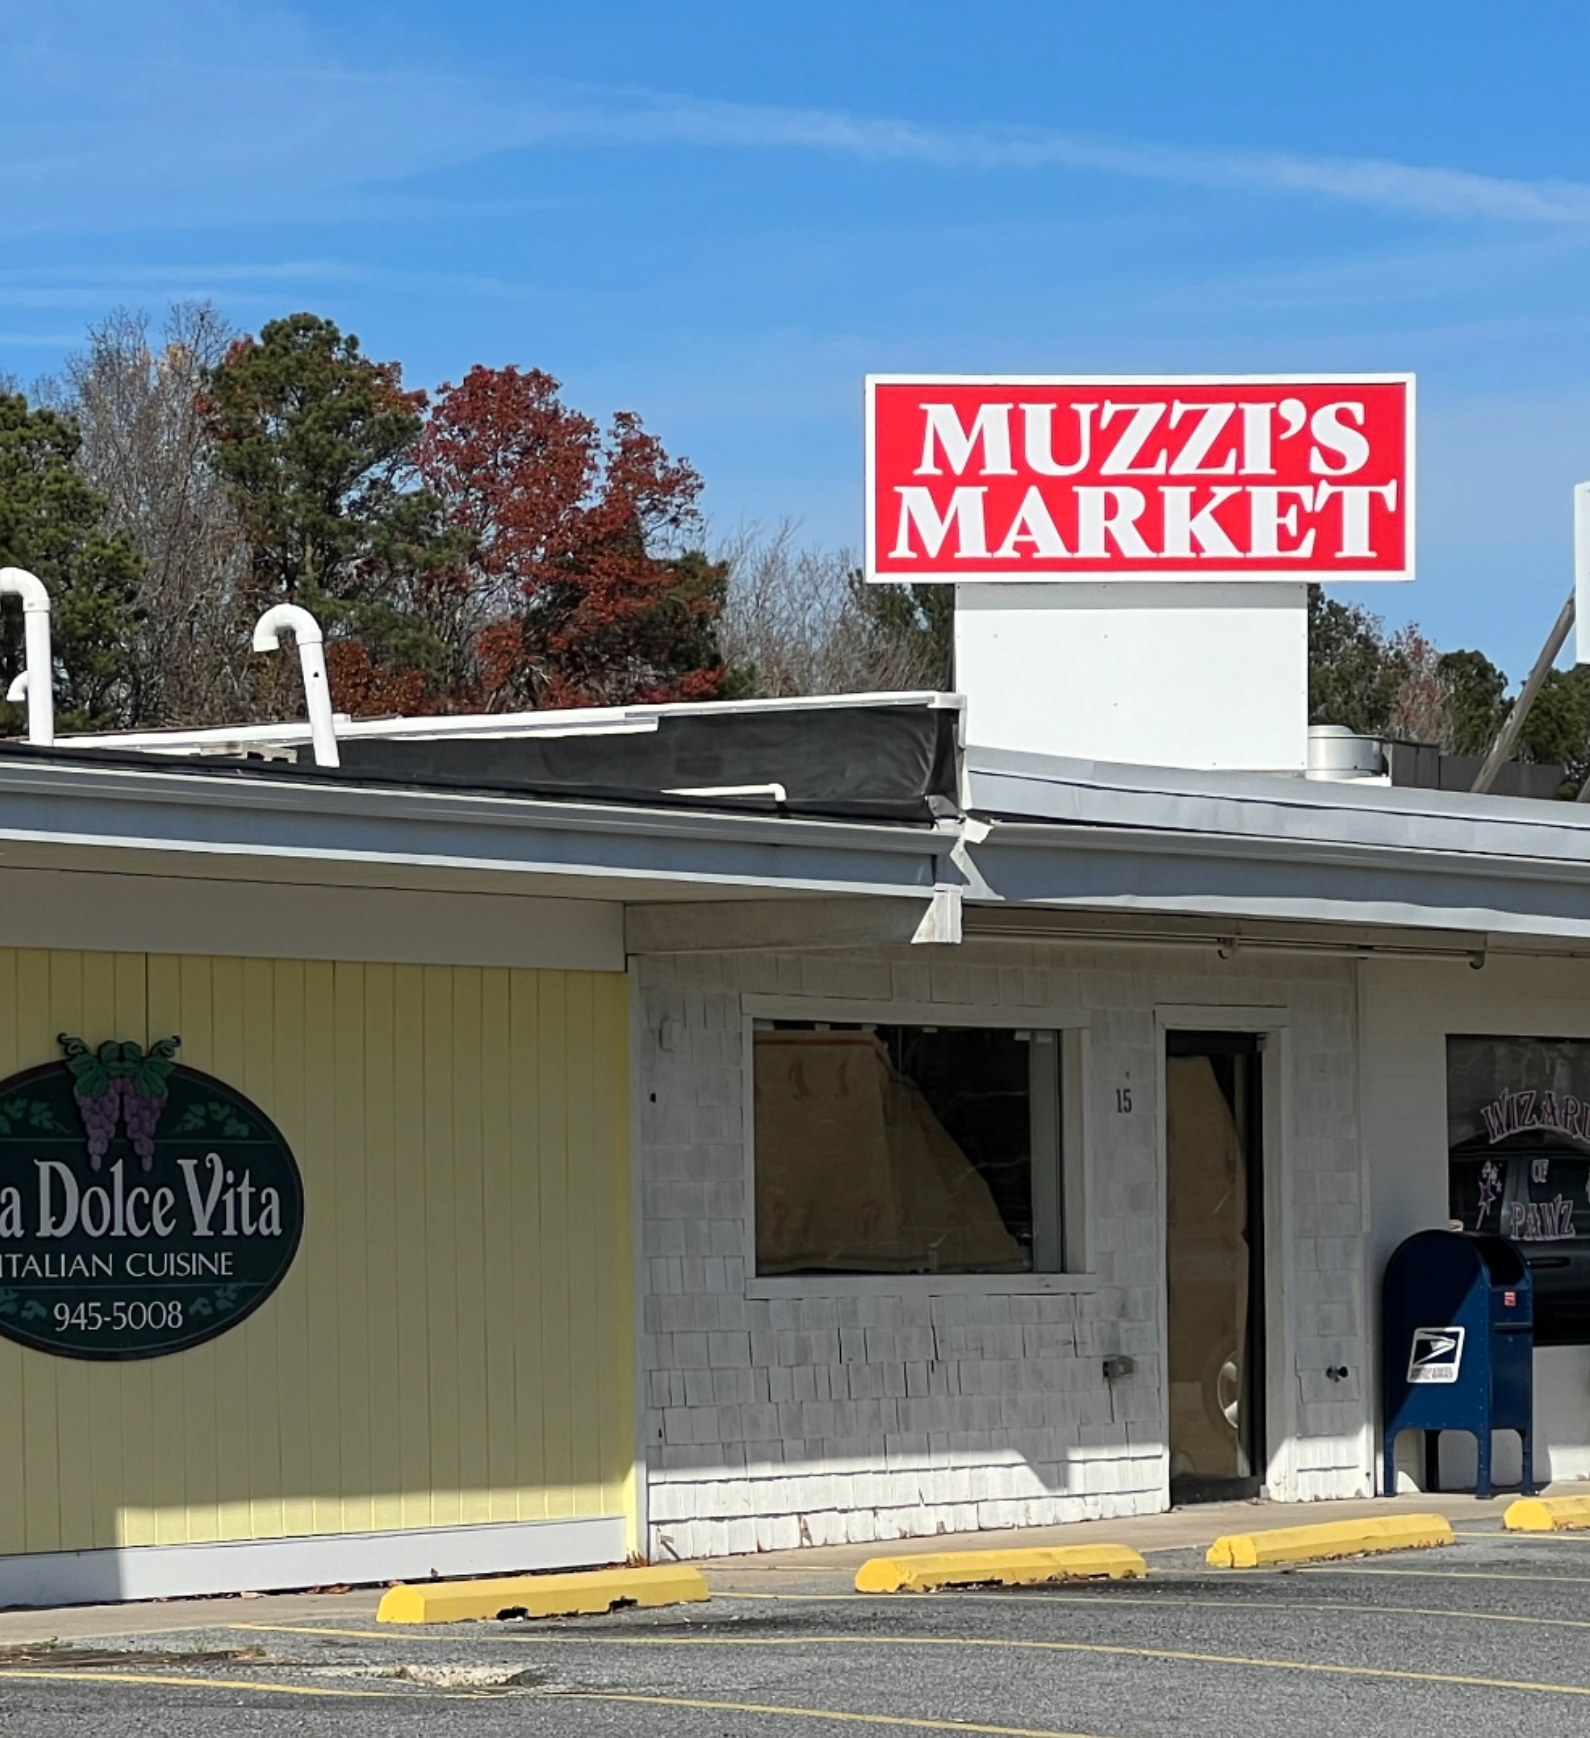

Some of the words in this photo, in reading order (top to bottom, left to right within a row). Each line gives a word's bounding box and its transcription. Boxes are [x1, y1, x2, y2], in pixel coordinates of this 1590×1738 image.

[912, 398, 1371, 477] MUZZI'S
[888, 479, 1398, 559] MARKET
[1116, 1088, 1133, 1114] 15
[1531, 1158, 1549, 1184] OF
[33, 1158, 177, 1238] Dolce
[177, 1152, 283, 1238] Vita
[1510, 1193, 1577, 1241] PAWZ
[125, 1251, 234, 1277] CUISINE
[53, 1300, 184, 1332] 945-5008
